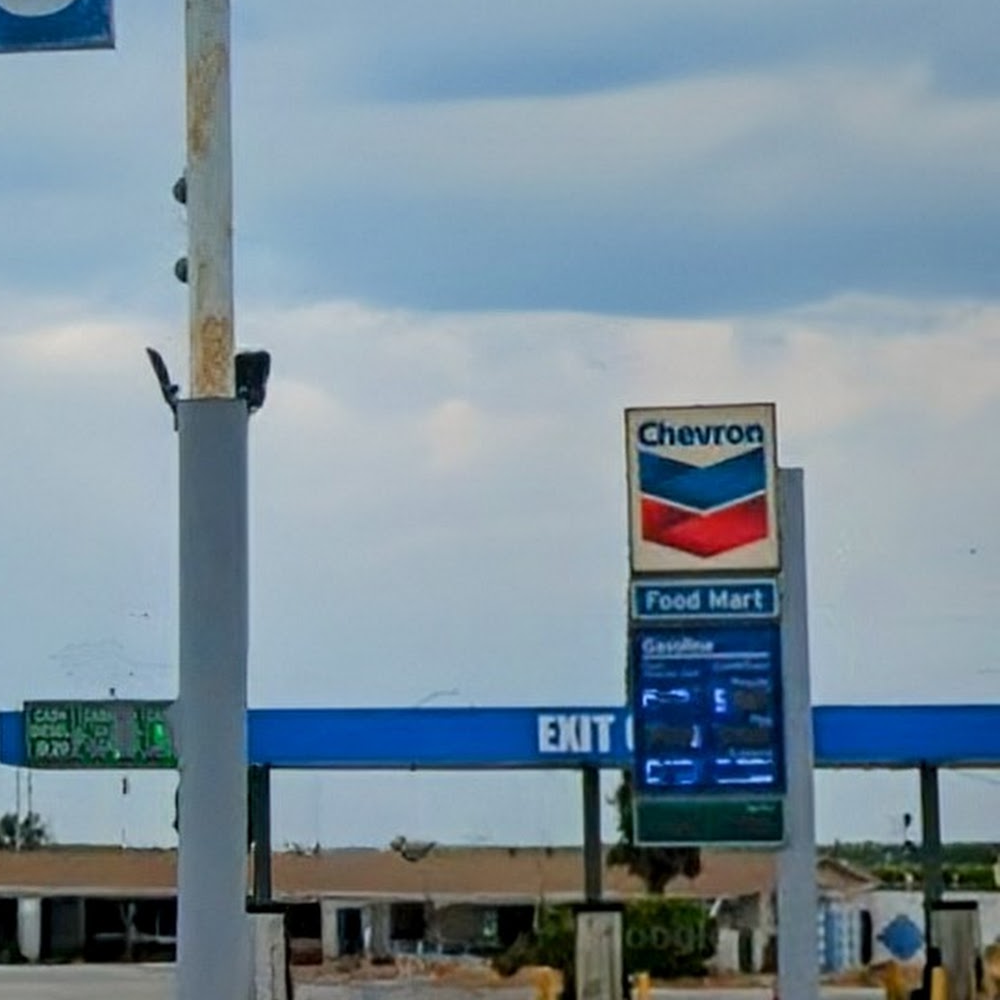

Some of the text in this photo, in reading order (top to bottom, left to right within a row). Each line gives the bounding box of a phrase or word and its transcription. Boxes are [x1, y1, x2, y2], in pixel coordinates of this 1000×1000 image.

[638, 421, 764, 446] Chevron
[645, 588, 764, 611] Food Mart
[538, 713, 616, 753] EXIT
